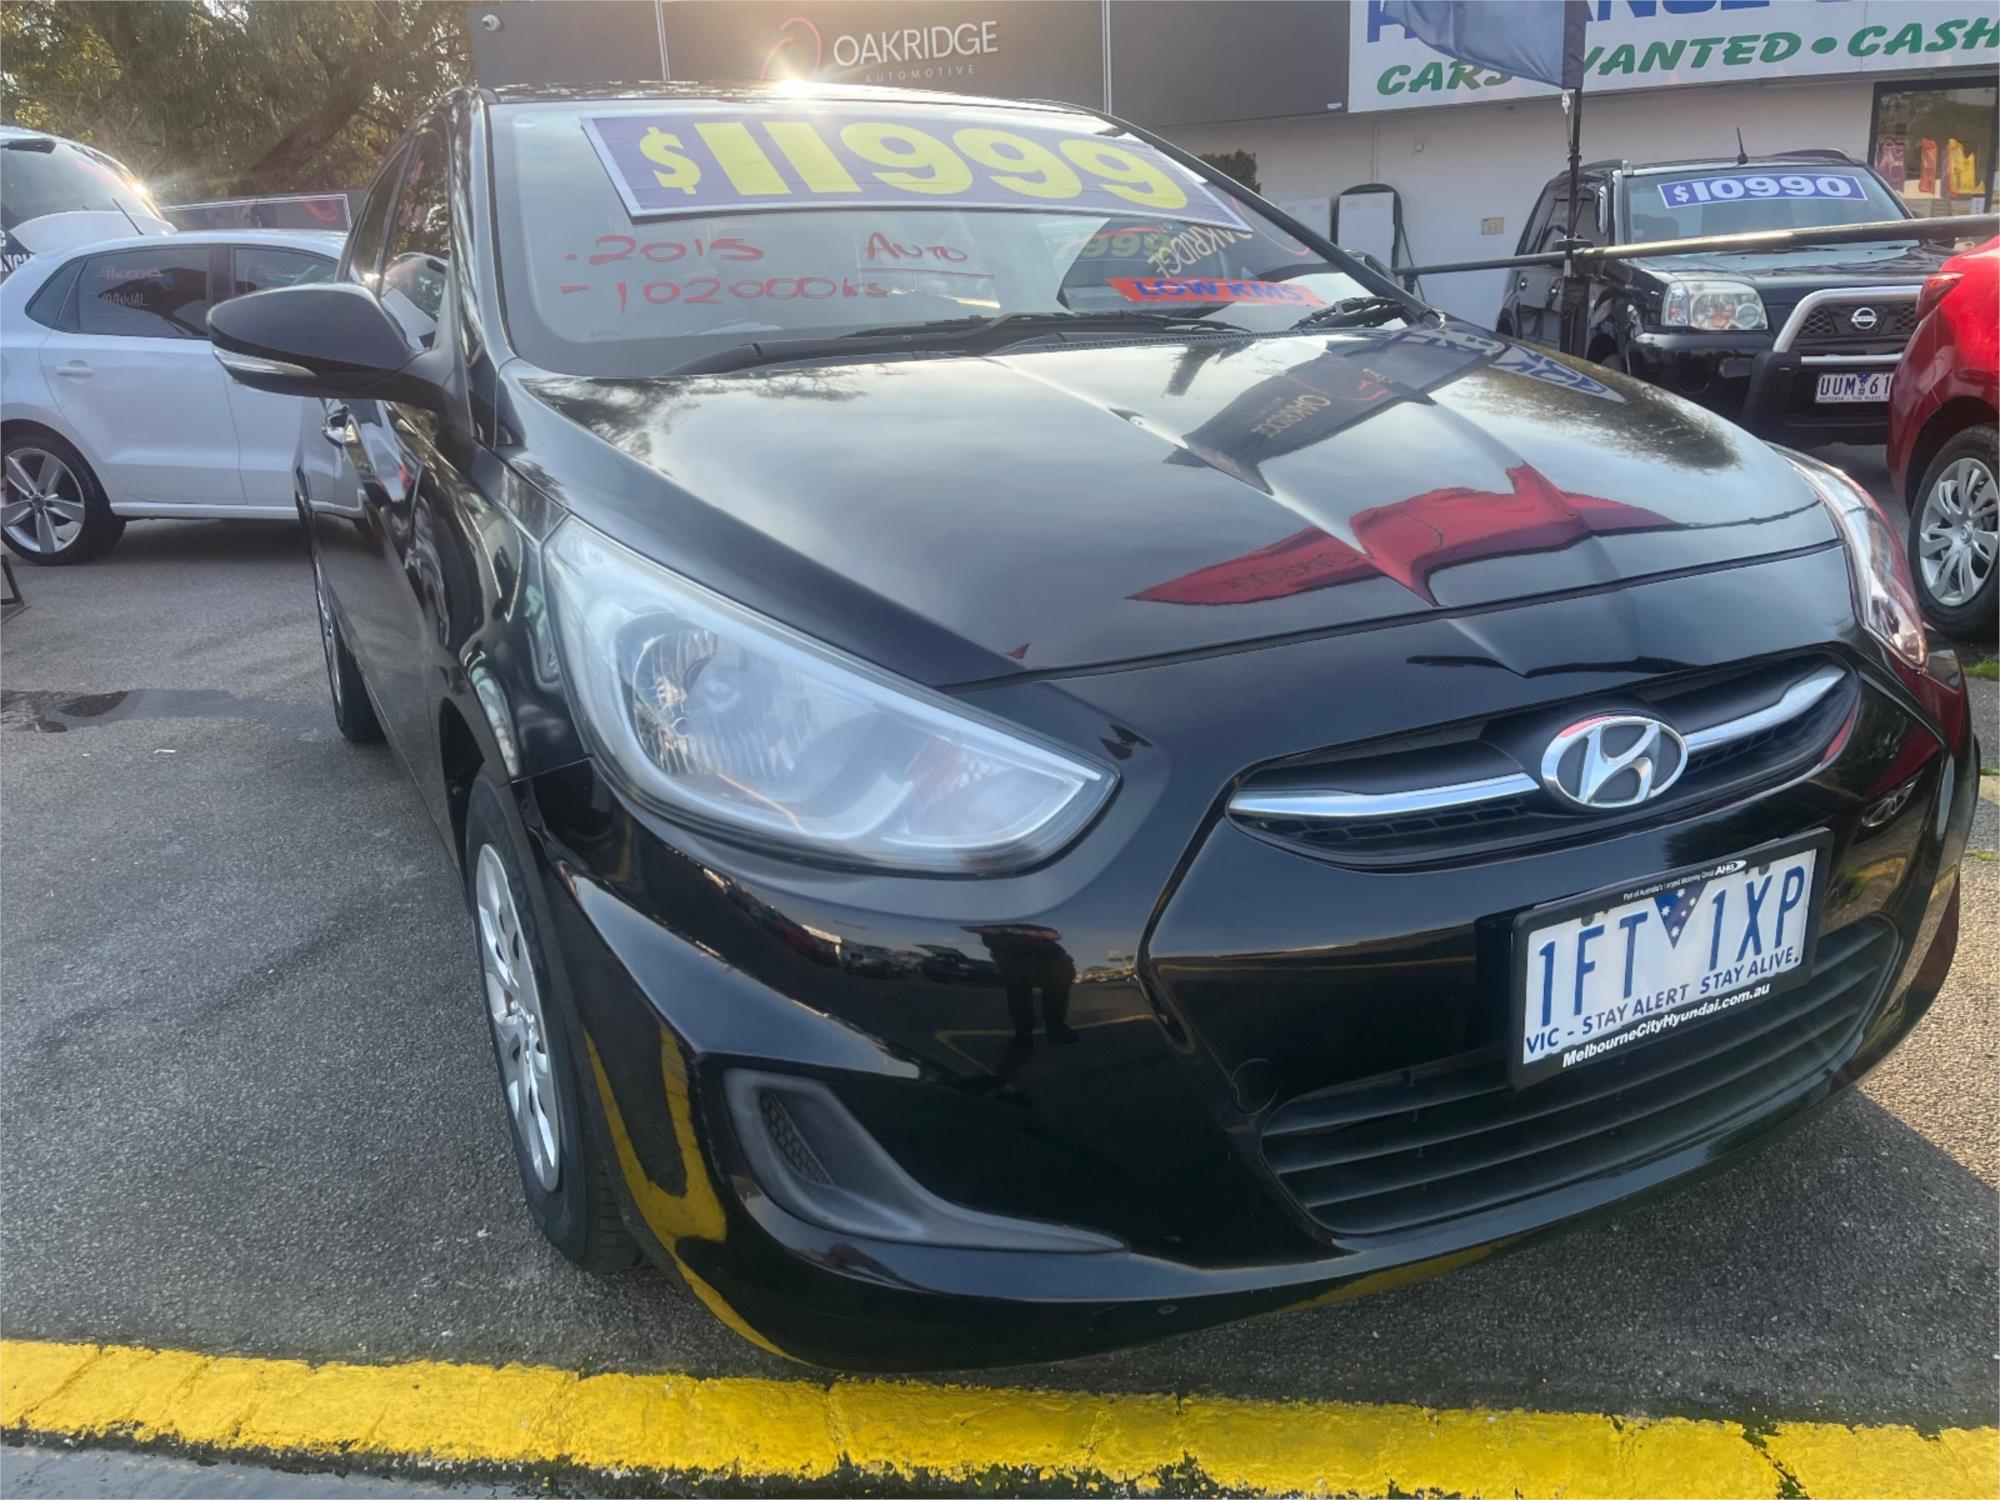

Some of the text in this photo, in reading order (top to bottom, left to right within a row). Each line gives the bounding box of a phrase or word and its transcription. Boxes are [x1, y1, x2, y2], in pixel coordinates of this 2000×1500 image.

[833, 20, 998, 66] OAKRIDGE
[1582, 31, 1802, 77] ANTED
[1847, 16, 1999, 57] CASH
[865, 64, 976, 83] AUTOMOTIVE
[638, 121, 1188, 209] $11999
[1673, 176, 1852, 202] $10990
[1133, 279, 1304, 300] LOW KMS
[1819, 375, 1891, 396] UUM 61
[1538, 865, 1805, 1028] 1FT 1XP
[1526, 1028, 1559, 1054] VIC
[1582, 1003, 1633, 1036] STAY
[1632, 983, 1691, 1019] ALERT
[1699, 964, 1744, 996] STAY
[1562, 983, 1771, 1069] MelbourneCityHyundai.com.au
